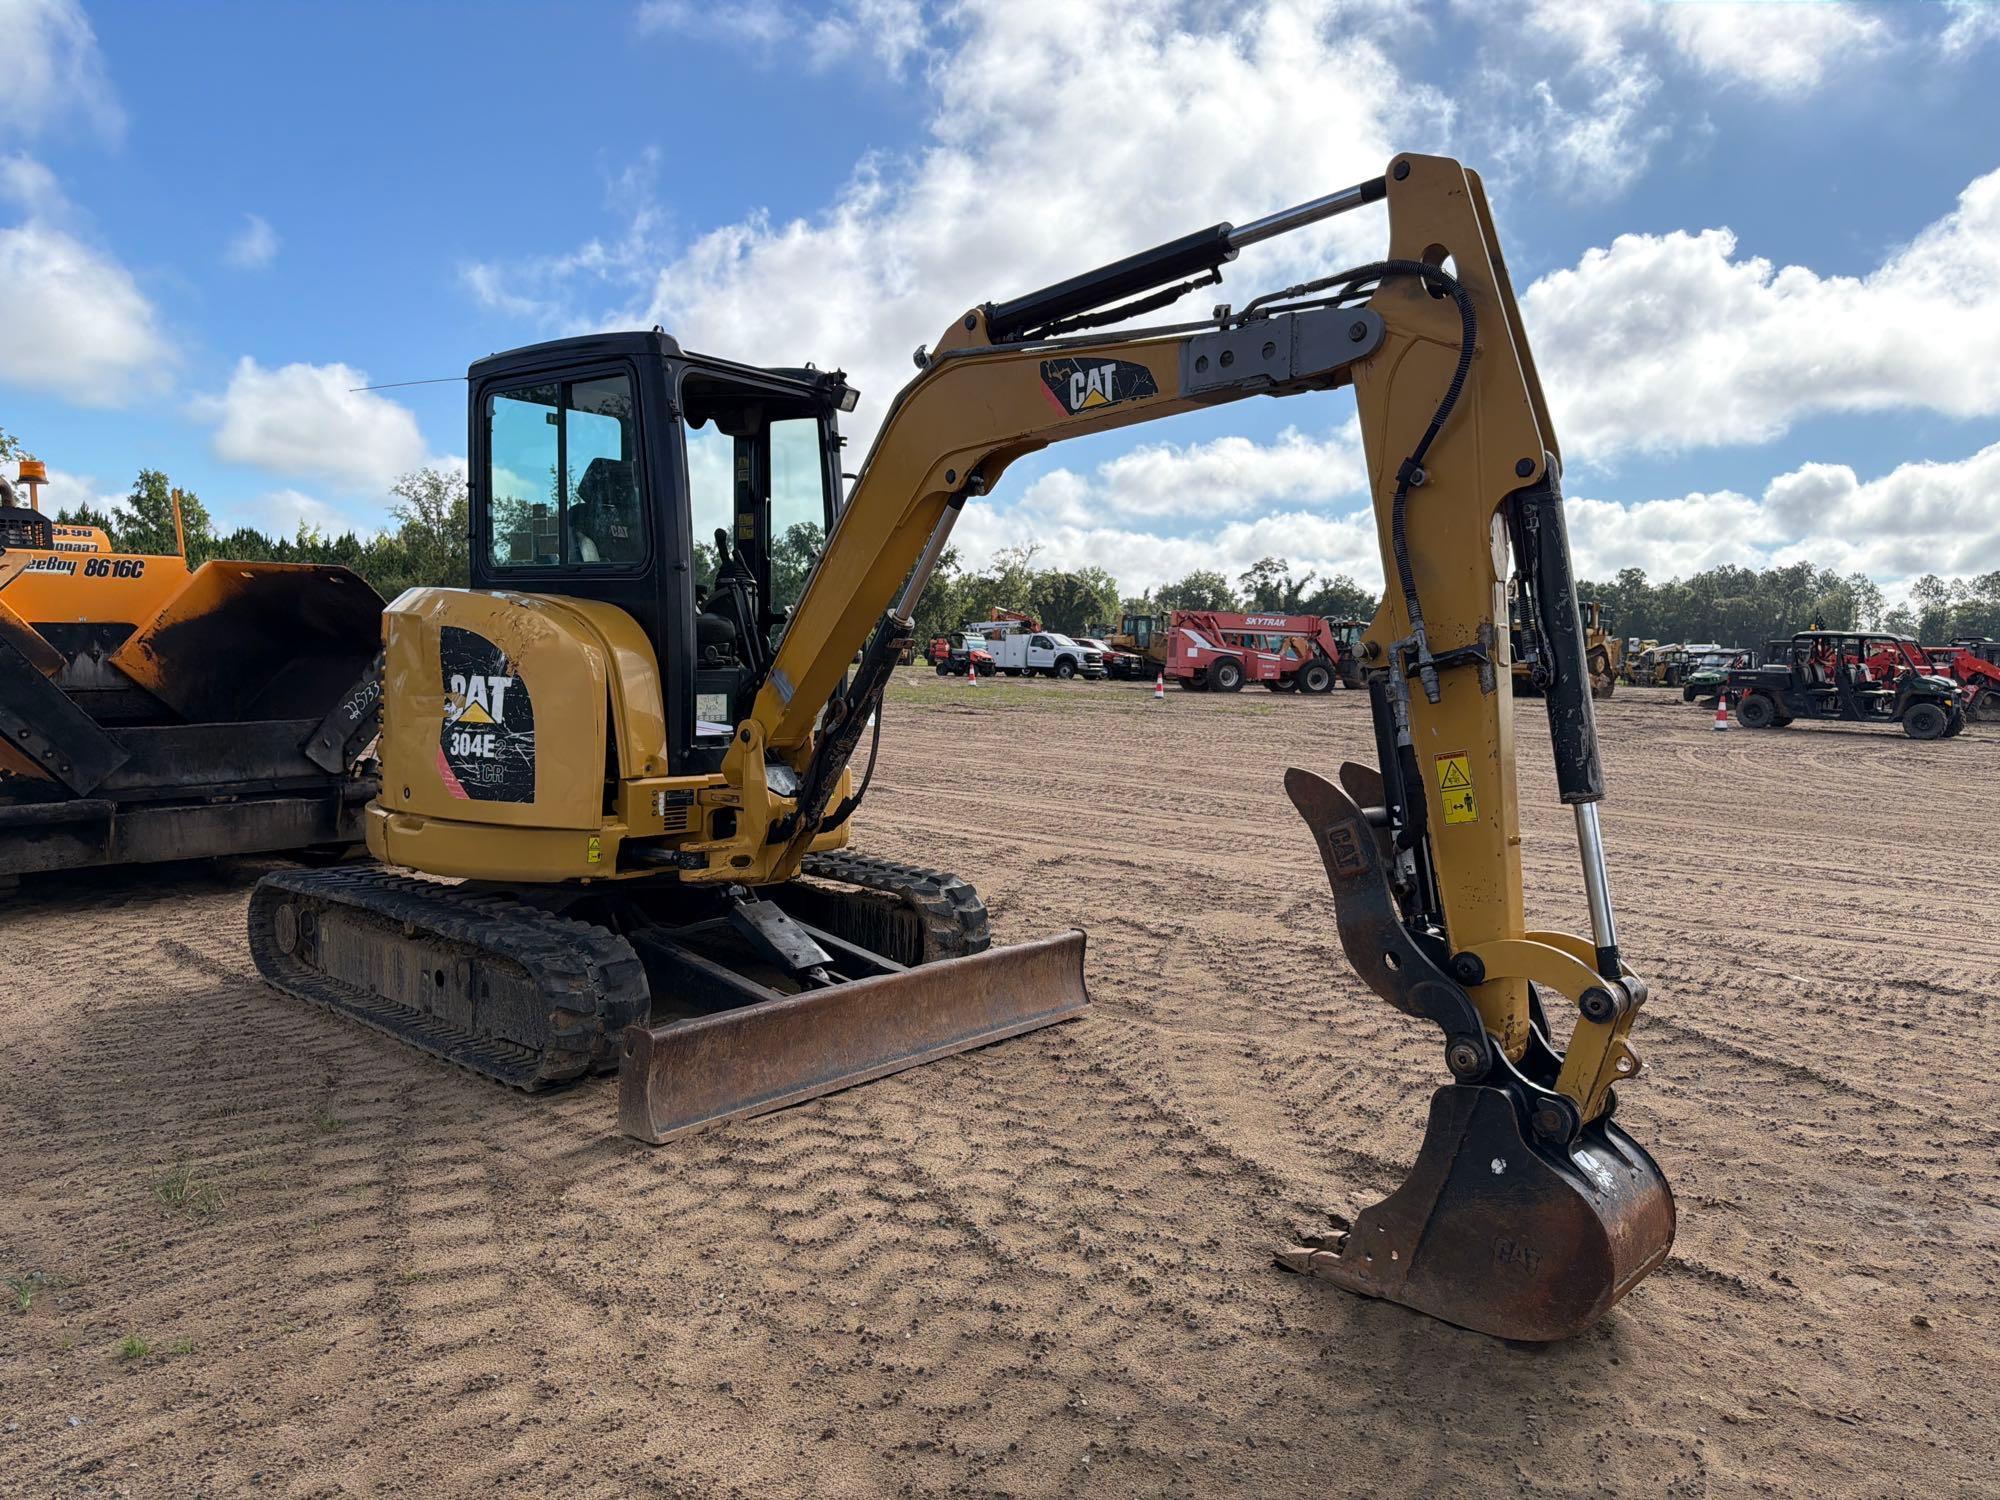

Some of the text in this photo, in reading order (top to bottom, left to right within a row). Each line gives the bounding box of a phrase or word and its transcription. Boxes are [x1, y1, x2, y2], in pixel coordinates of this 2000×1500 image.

[1070, 363, 1116, 410] CAT
[611, 525, 628, 538] CAT
[27, 556, 145, 579] eeBoy 8616C
[1245, 617, 1287, 627] SKYTRAK
[481, 763, 504, 783] CR
